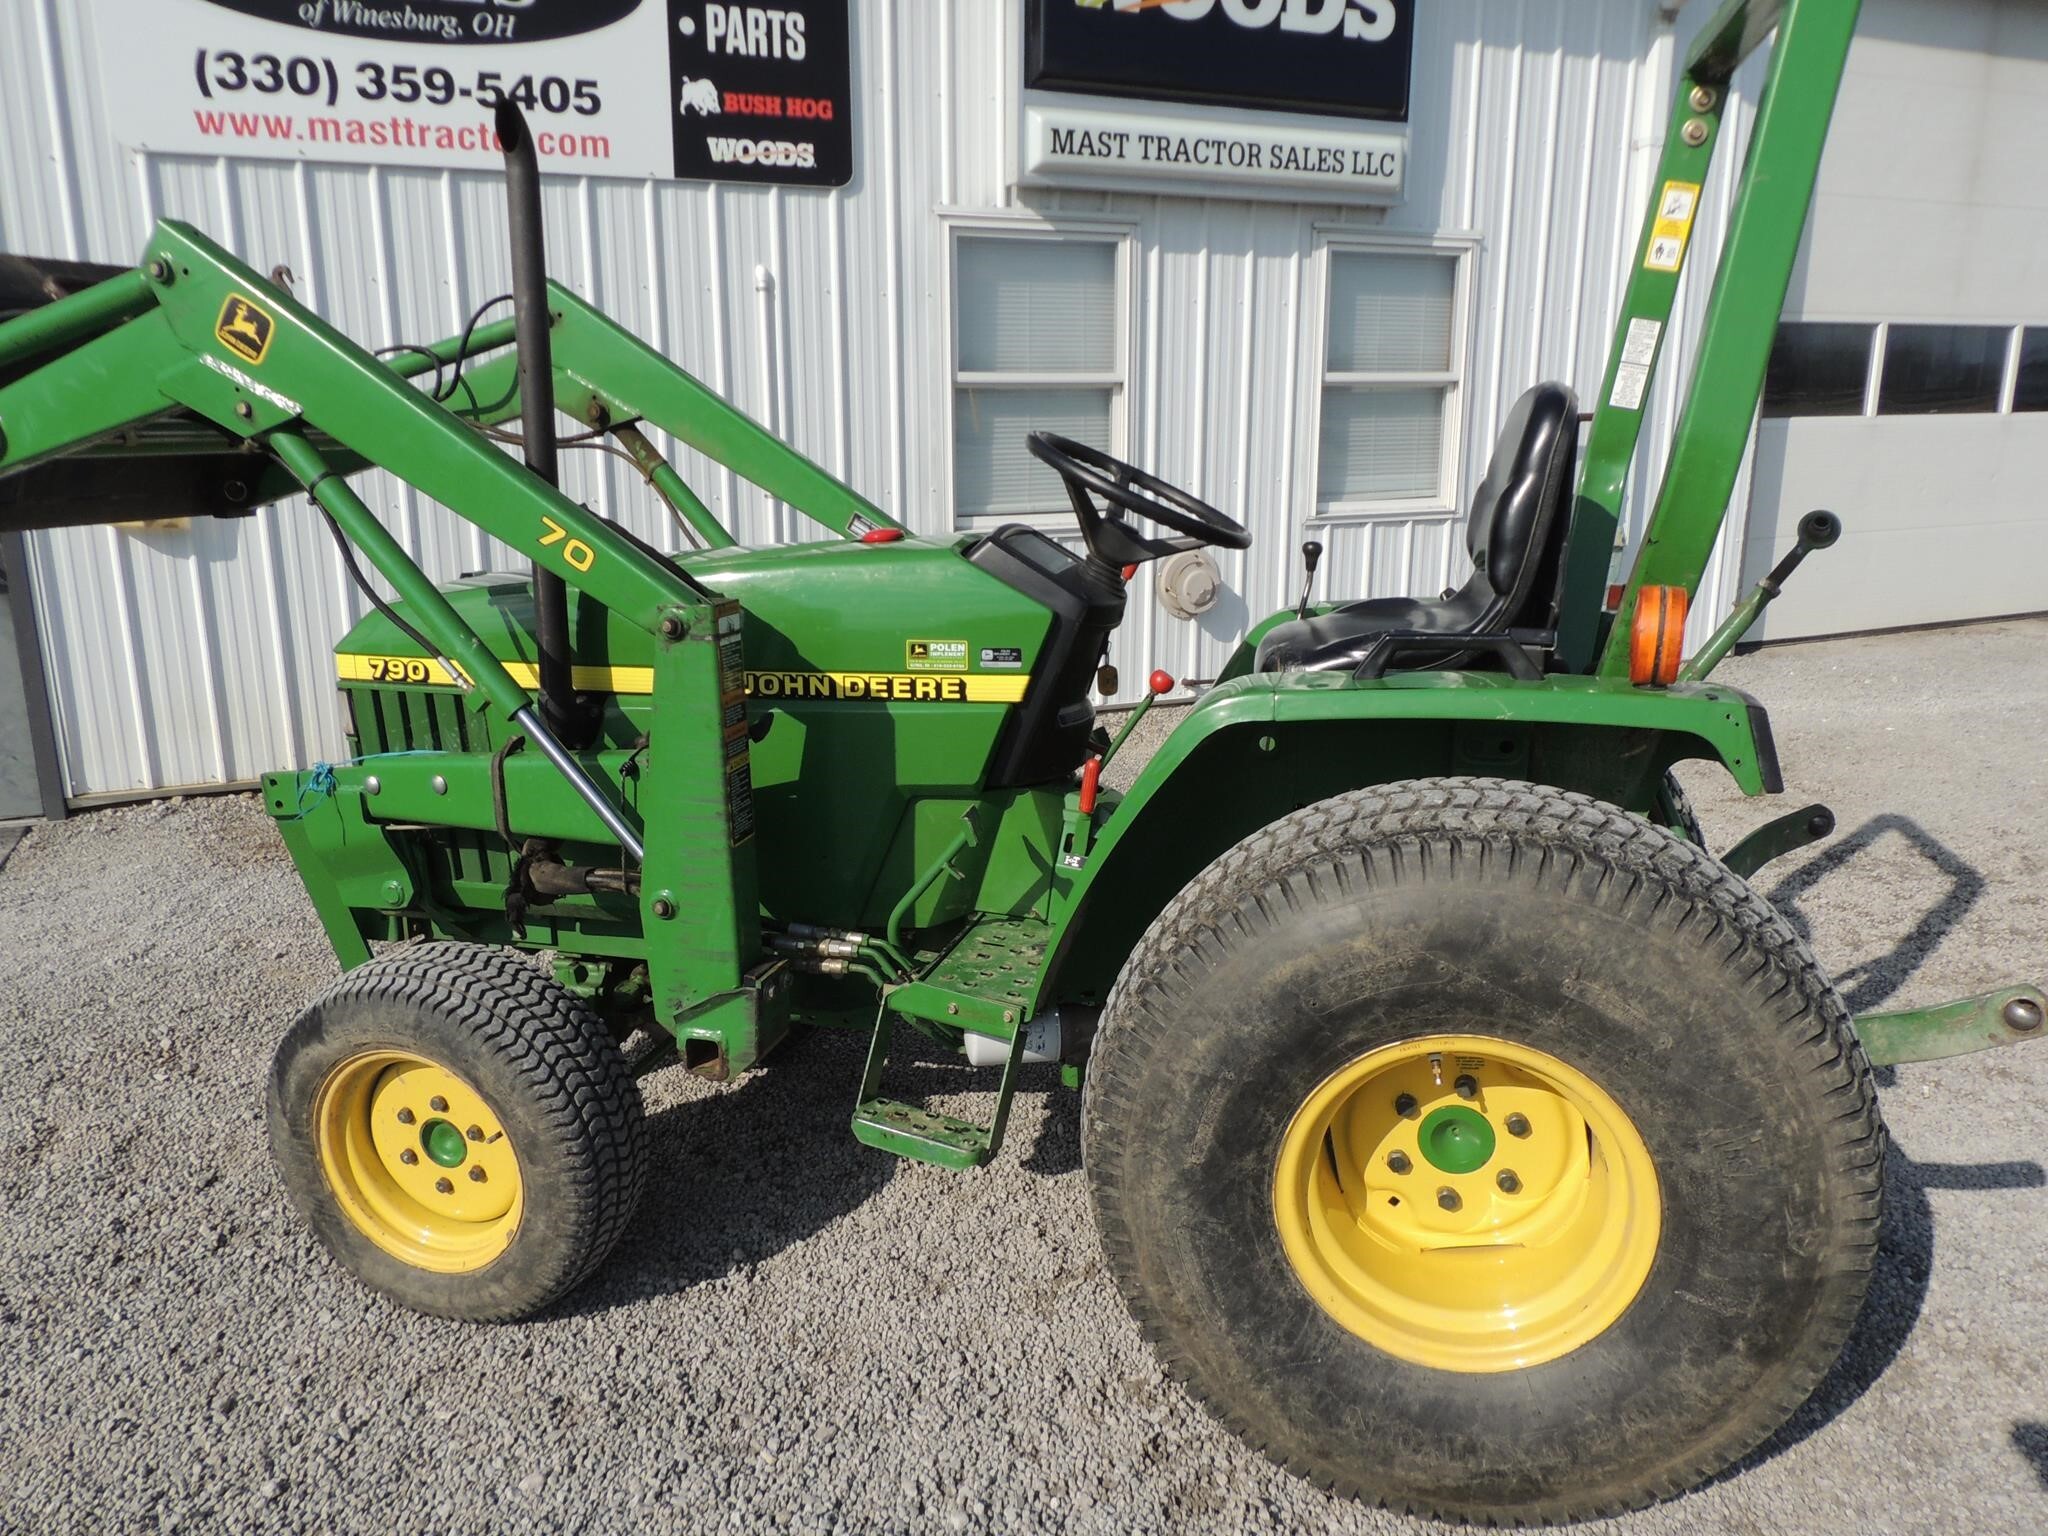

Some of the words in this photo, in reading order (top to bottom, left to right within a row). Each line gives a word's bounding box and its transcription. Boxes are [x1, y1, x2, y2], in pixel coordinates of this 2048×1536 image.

[298, 2, 327, 28] of
[332, 0, 462, 39] Winesburg,
[472, 11, 515, 38] OH
[705, 3, 807, 61] PARTS
[196, 48, 338, 106] (330)
[356, 62, 602, 116] 359-5405
[723, 91, 782, 117] BUSH
[786, 97, 833, 120] HOG
[706, 136, 816, 168] WOODS
[1050, 127, 1129, 159] MAST
[1139, 135, 1262, 169] TRACTOR
[1269, 144, 1344, 174] SALES
[1351, 150, 1395, 178] LLC
[537, 515, 596, 573] 70
[369, 659, 430, 682] 790
[744, 673, 830, 697] JOHN
[842, 675, 967, 700] DEERE
